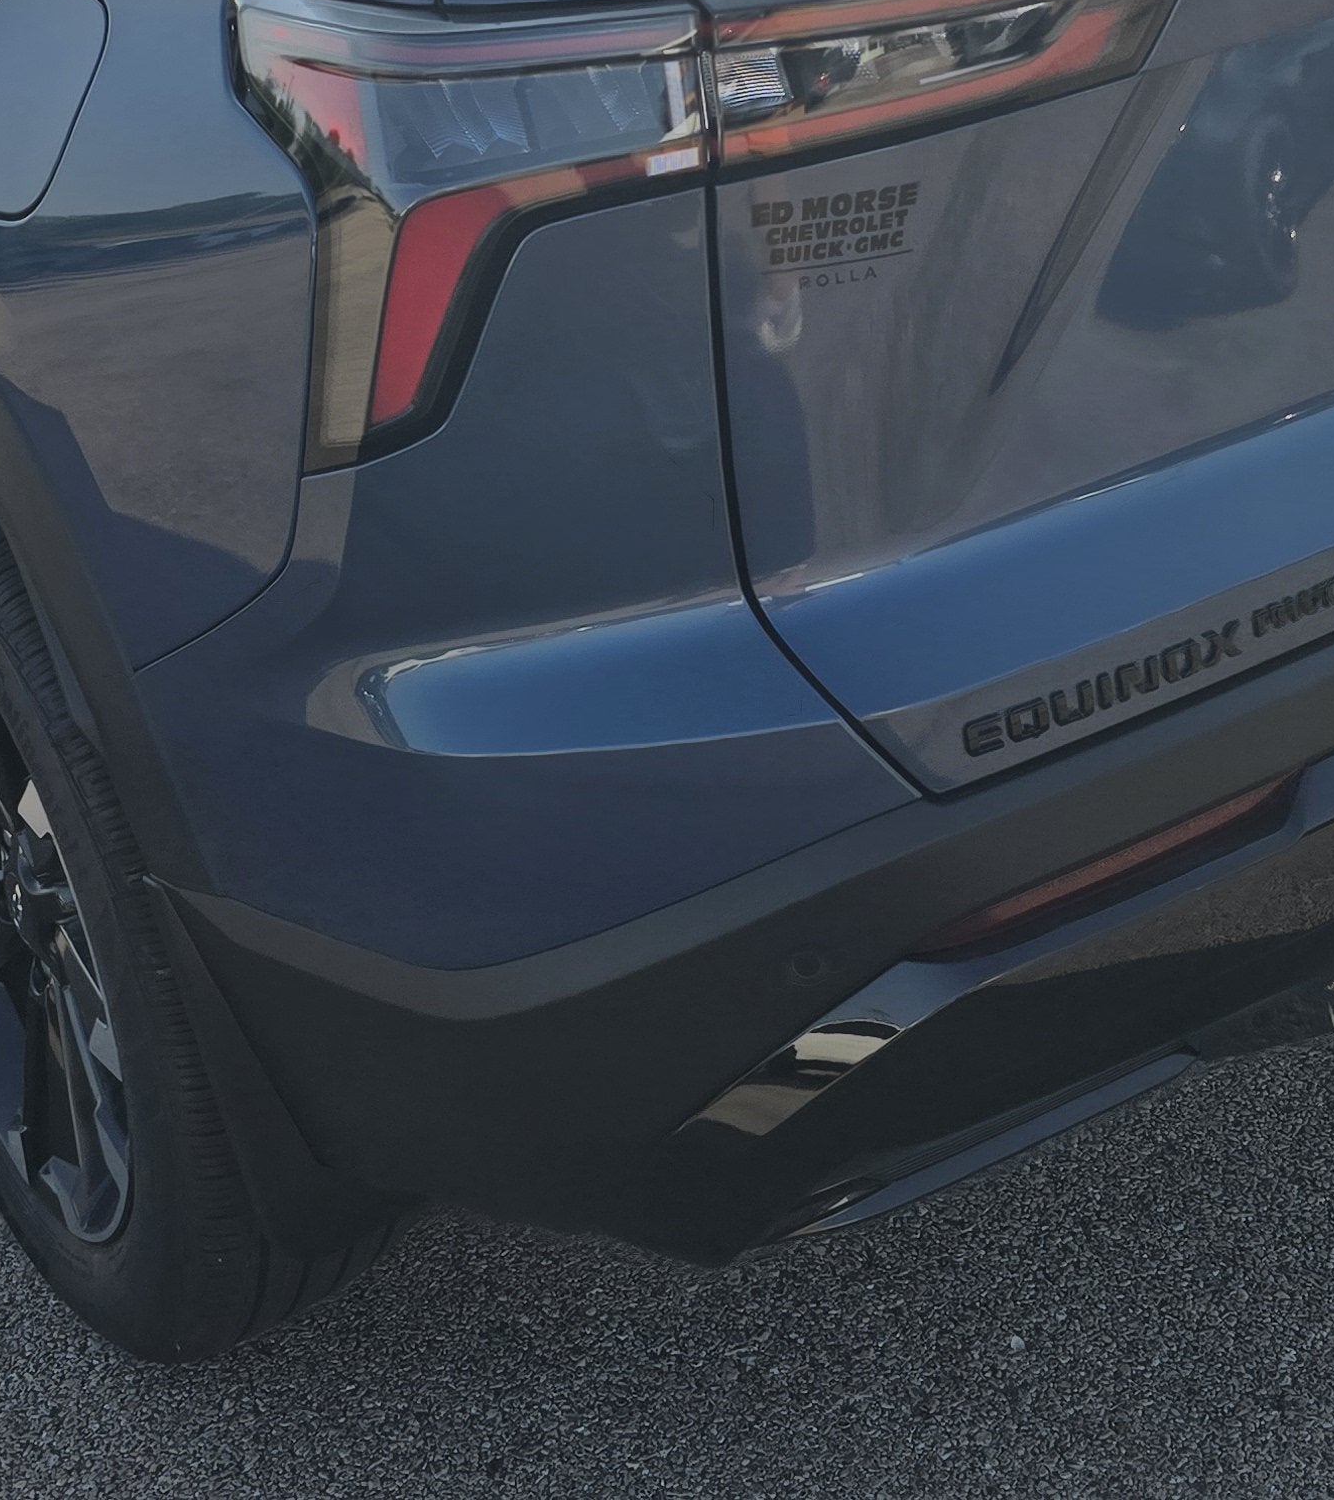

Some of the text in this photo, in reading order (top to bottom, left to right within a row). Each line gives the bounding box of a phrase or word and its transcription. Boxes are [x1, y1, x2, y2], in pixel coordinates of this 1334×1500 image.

[751, 181, 921, 228] ED MORSE
[766, 209, 909, 246] CHEVROLET
[798, 266, 878, 290] ROLLA
[962, 619, 1244, 758] EQUINOX
